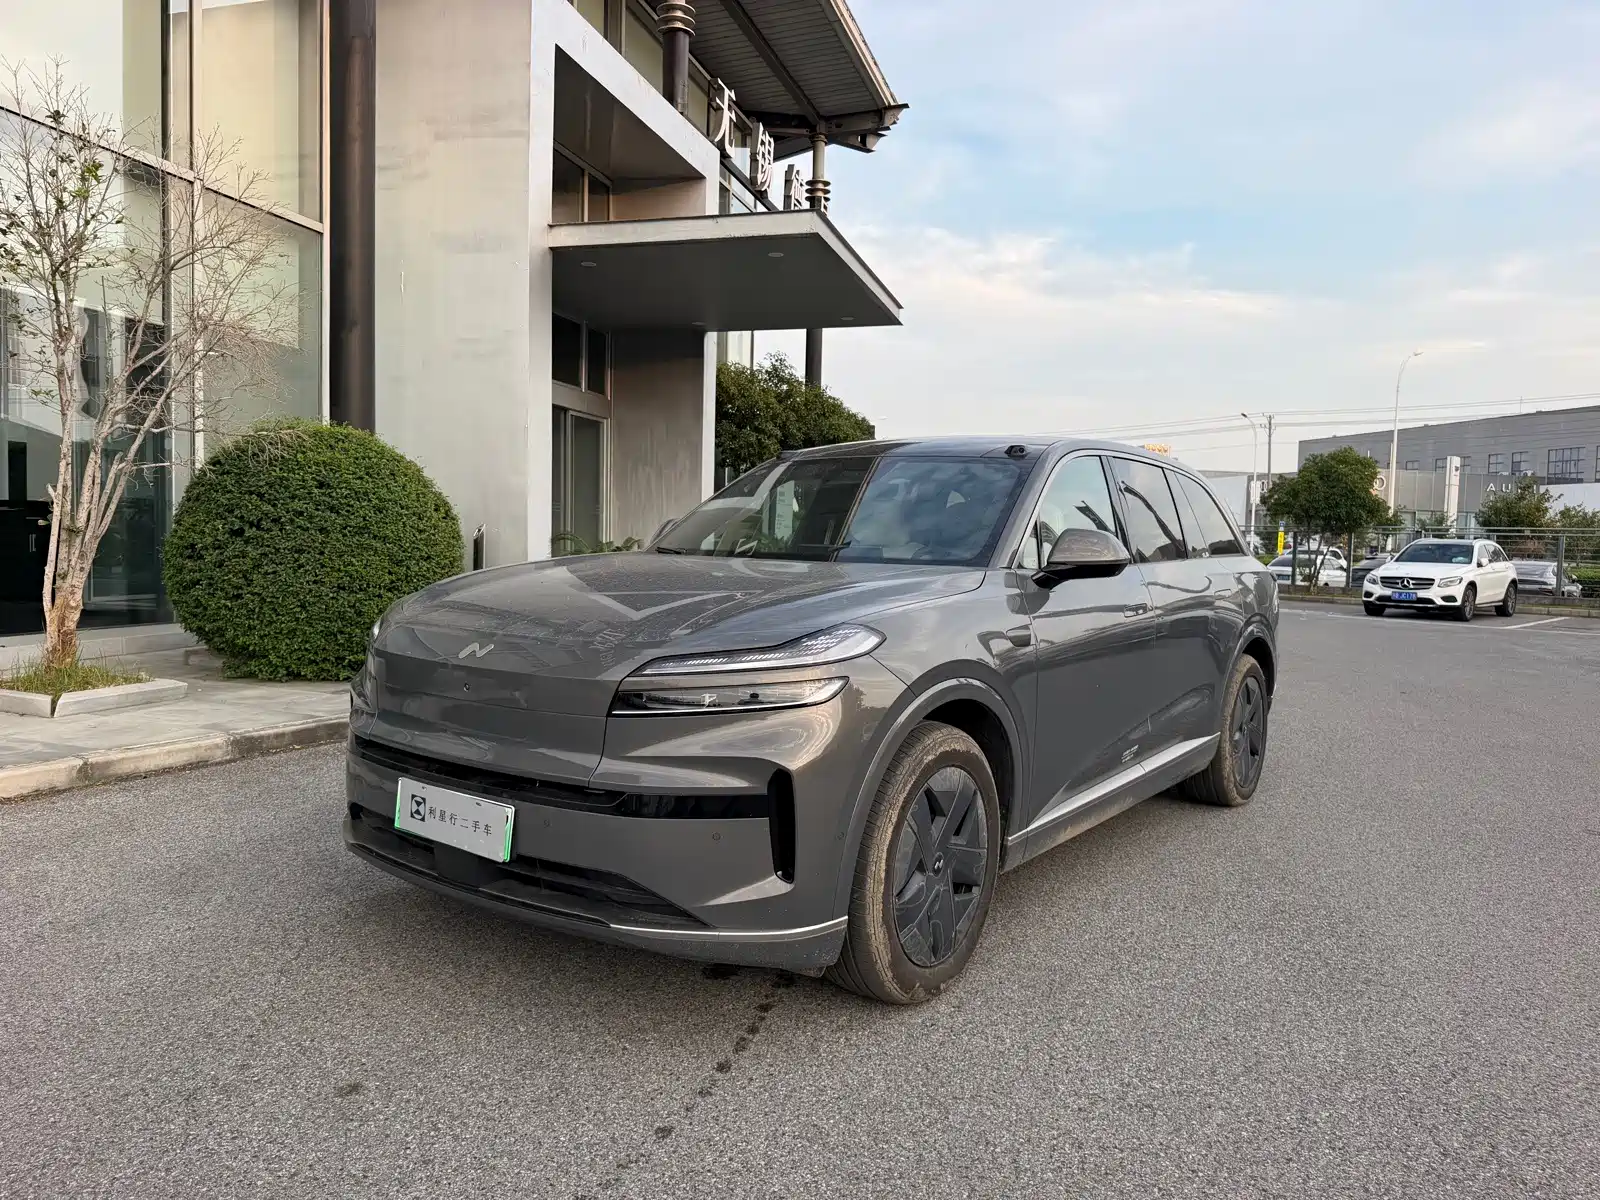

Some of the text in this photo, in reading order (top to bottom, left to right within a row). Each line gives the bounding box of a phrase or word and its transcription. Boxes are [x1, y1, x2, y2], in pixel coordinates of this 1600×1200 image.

[1486, 482, 1537, 494] AUI
[428, 806, 492, 837] 利星行二手车
